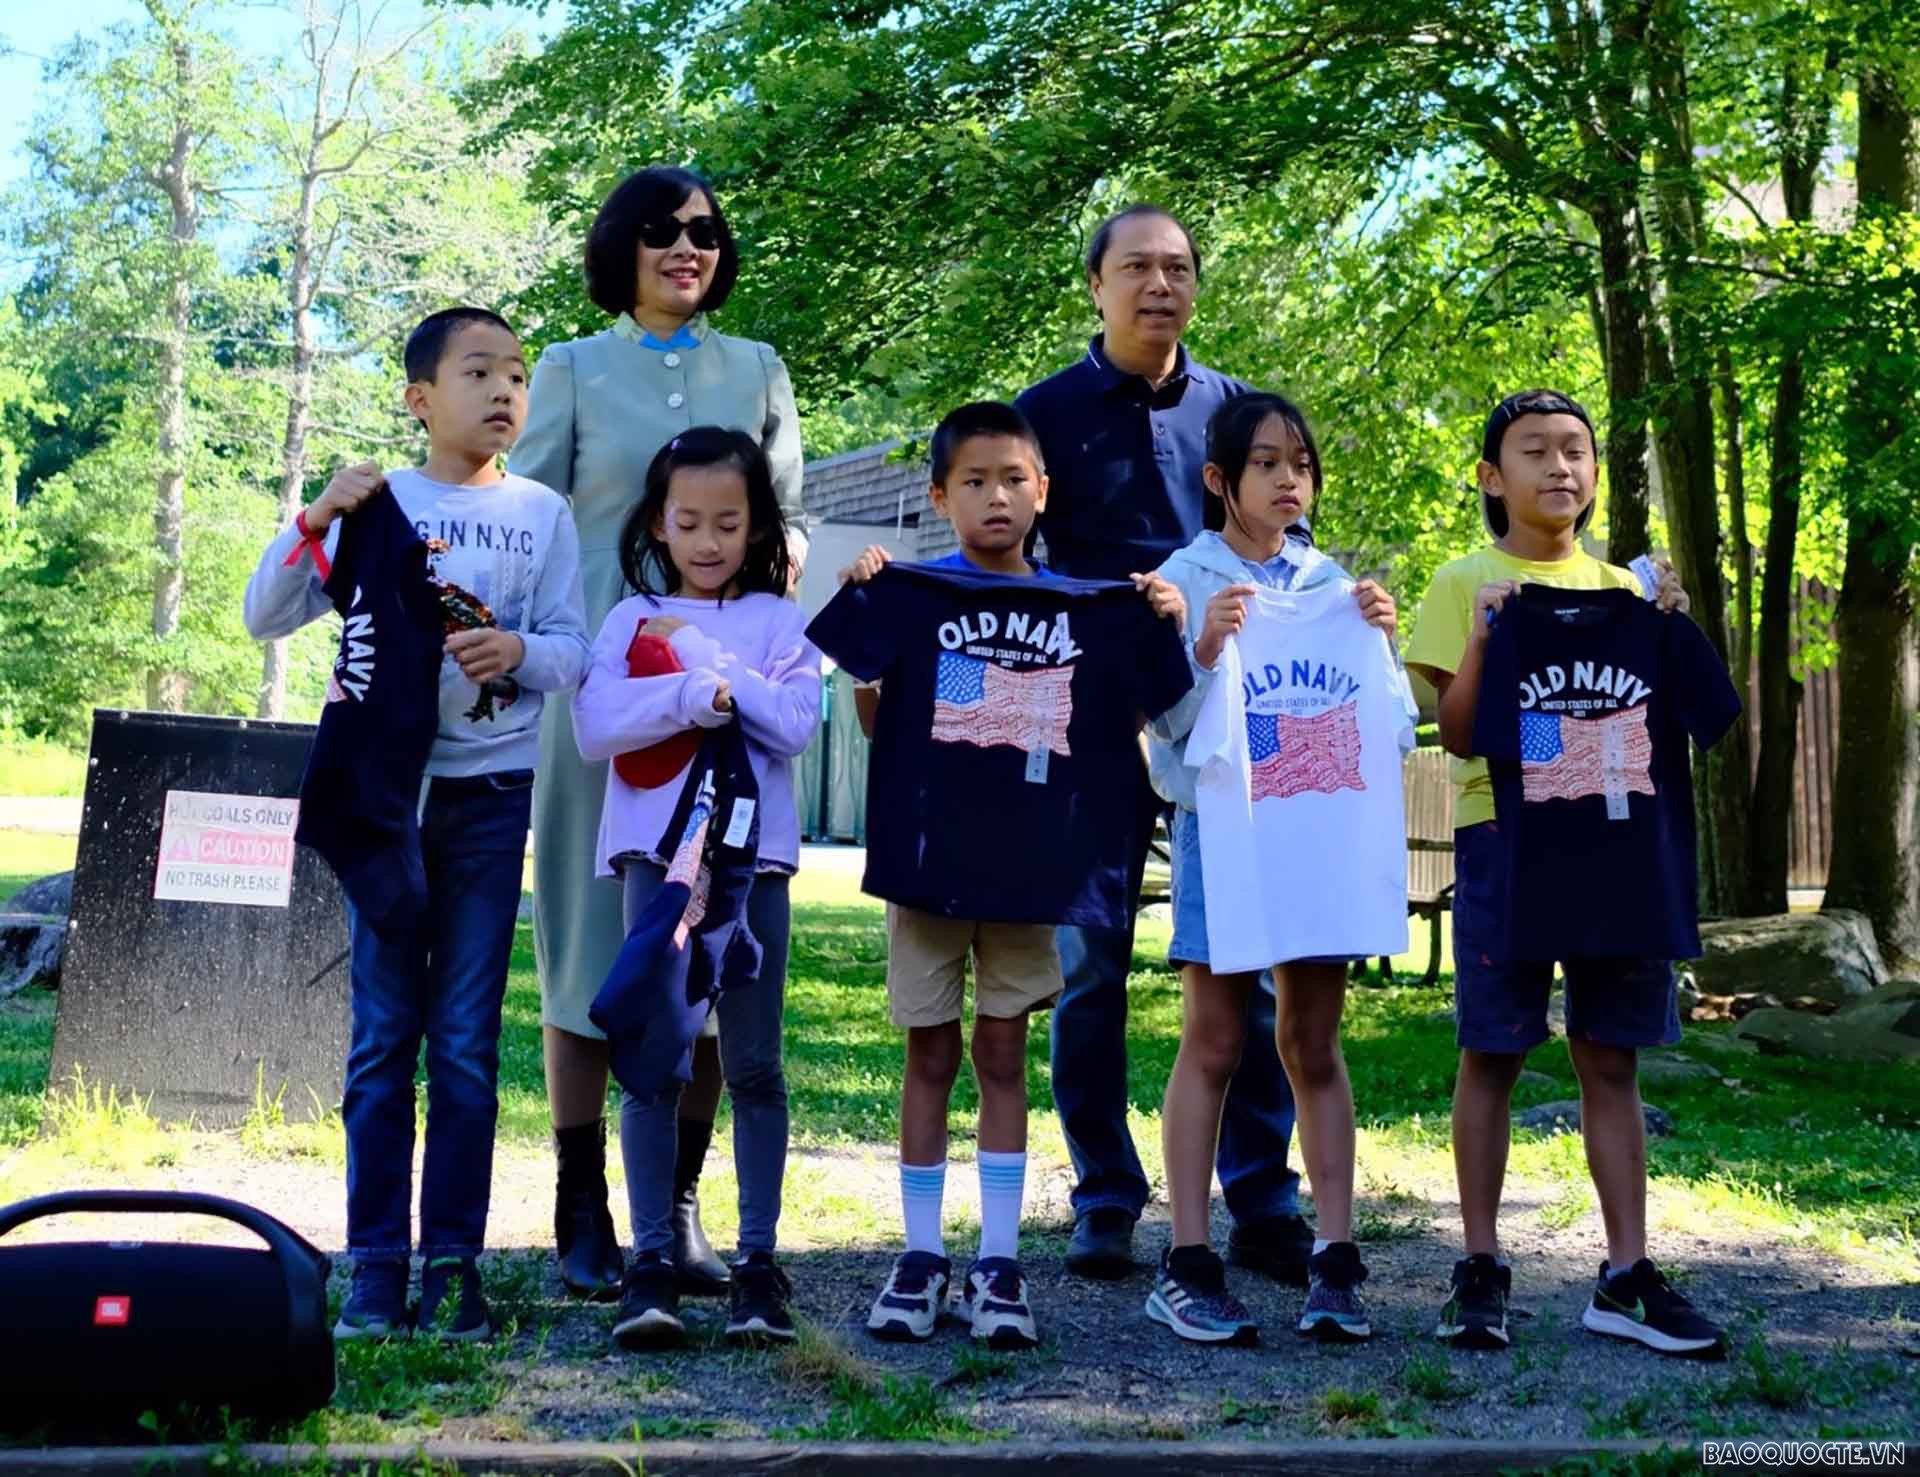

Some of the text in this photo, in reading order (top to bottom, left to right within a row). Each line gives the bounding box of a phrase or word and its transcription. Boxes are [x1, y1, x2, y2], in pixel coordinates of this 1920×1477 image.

[440, 520, 467, 547] IN
[938, 611, 999, 650] OLD
[341, 612, 377, 702] NAVY
[1291, 659, 1360, 703] NAVY
[1573, 660, 1652, 707] NAVY
[255, 808, 293, 826] ONLY
[201, 837, 286, 863] CAUTION
[166, 870, 281, 891] NO TRASH PLEASE
